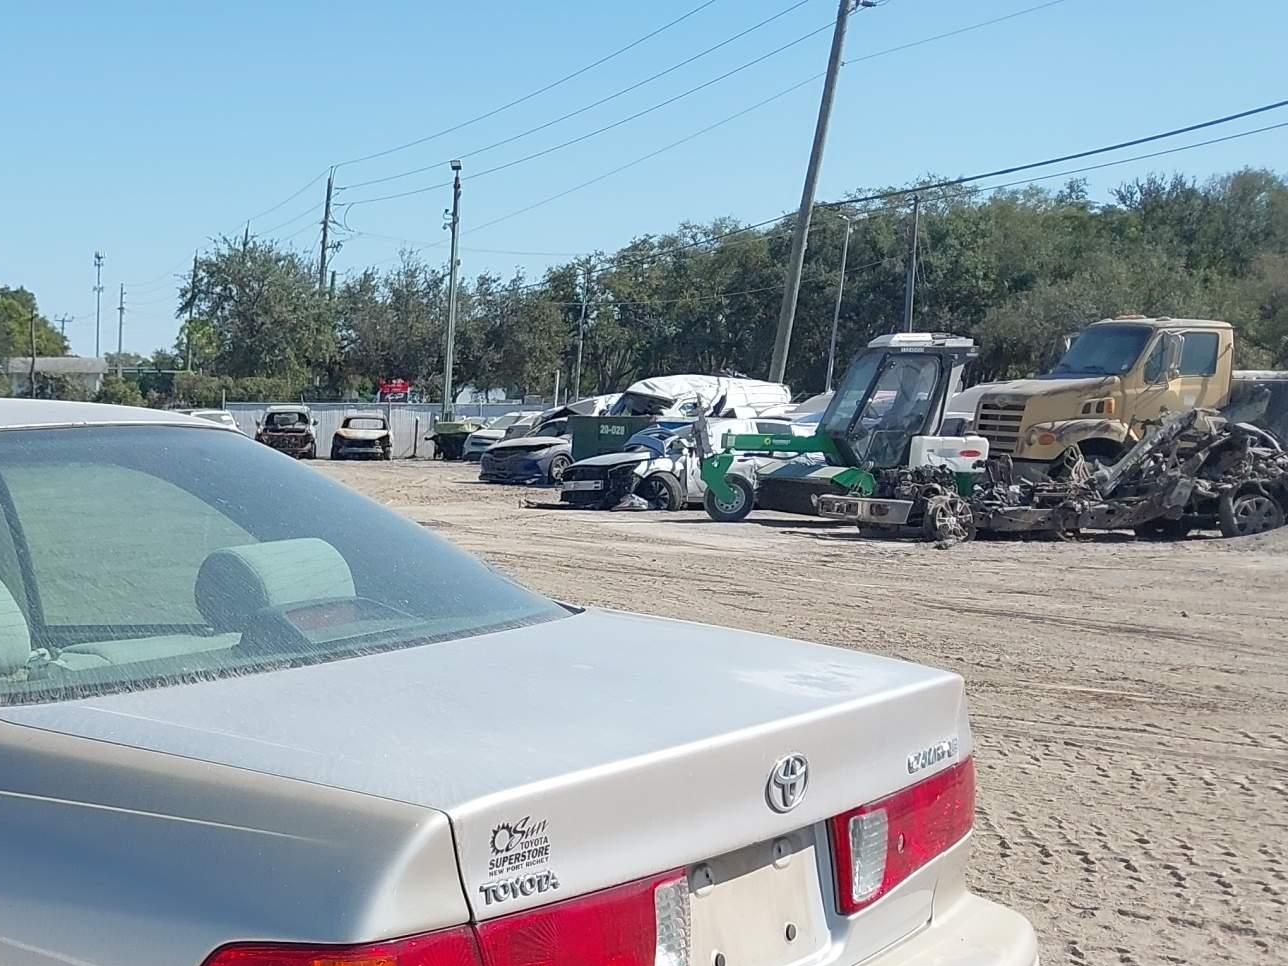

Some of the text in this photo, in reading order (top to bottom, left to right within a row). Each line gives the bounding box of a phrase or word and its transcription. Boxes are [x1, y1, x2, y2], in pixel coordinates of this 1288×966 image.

[505, 816, 548, 852] Sun
[520, 836, 548, 850] TOYOTA
[489, 845, 550, 870] SUPERSTORE
[507, 864, 524, 872] PORT
[526, 857, 549, 867] RICHEY
[479, 870, 560, 905] TOYOTA
